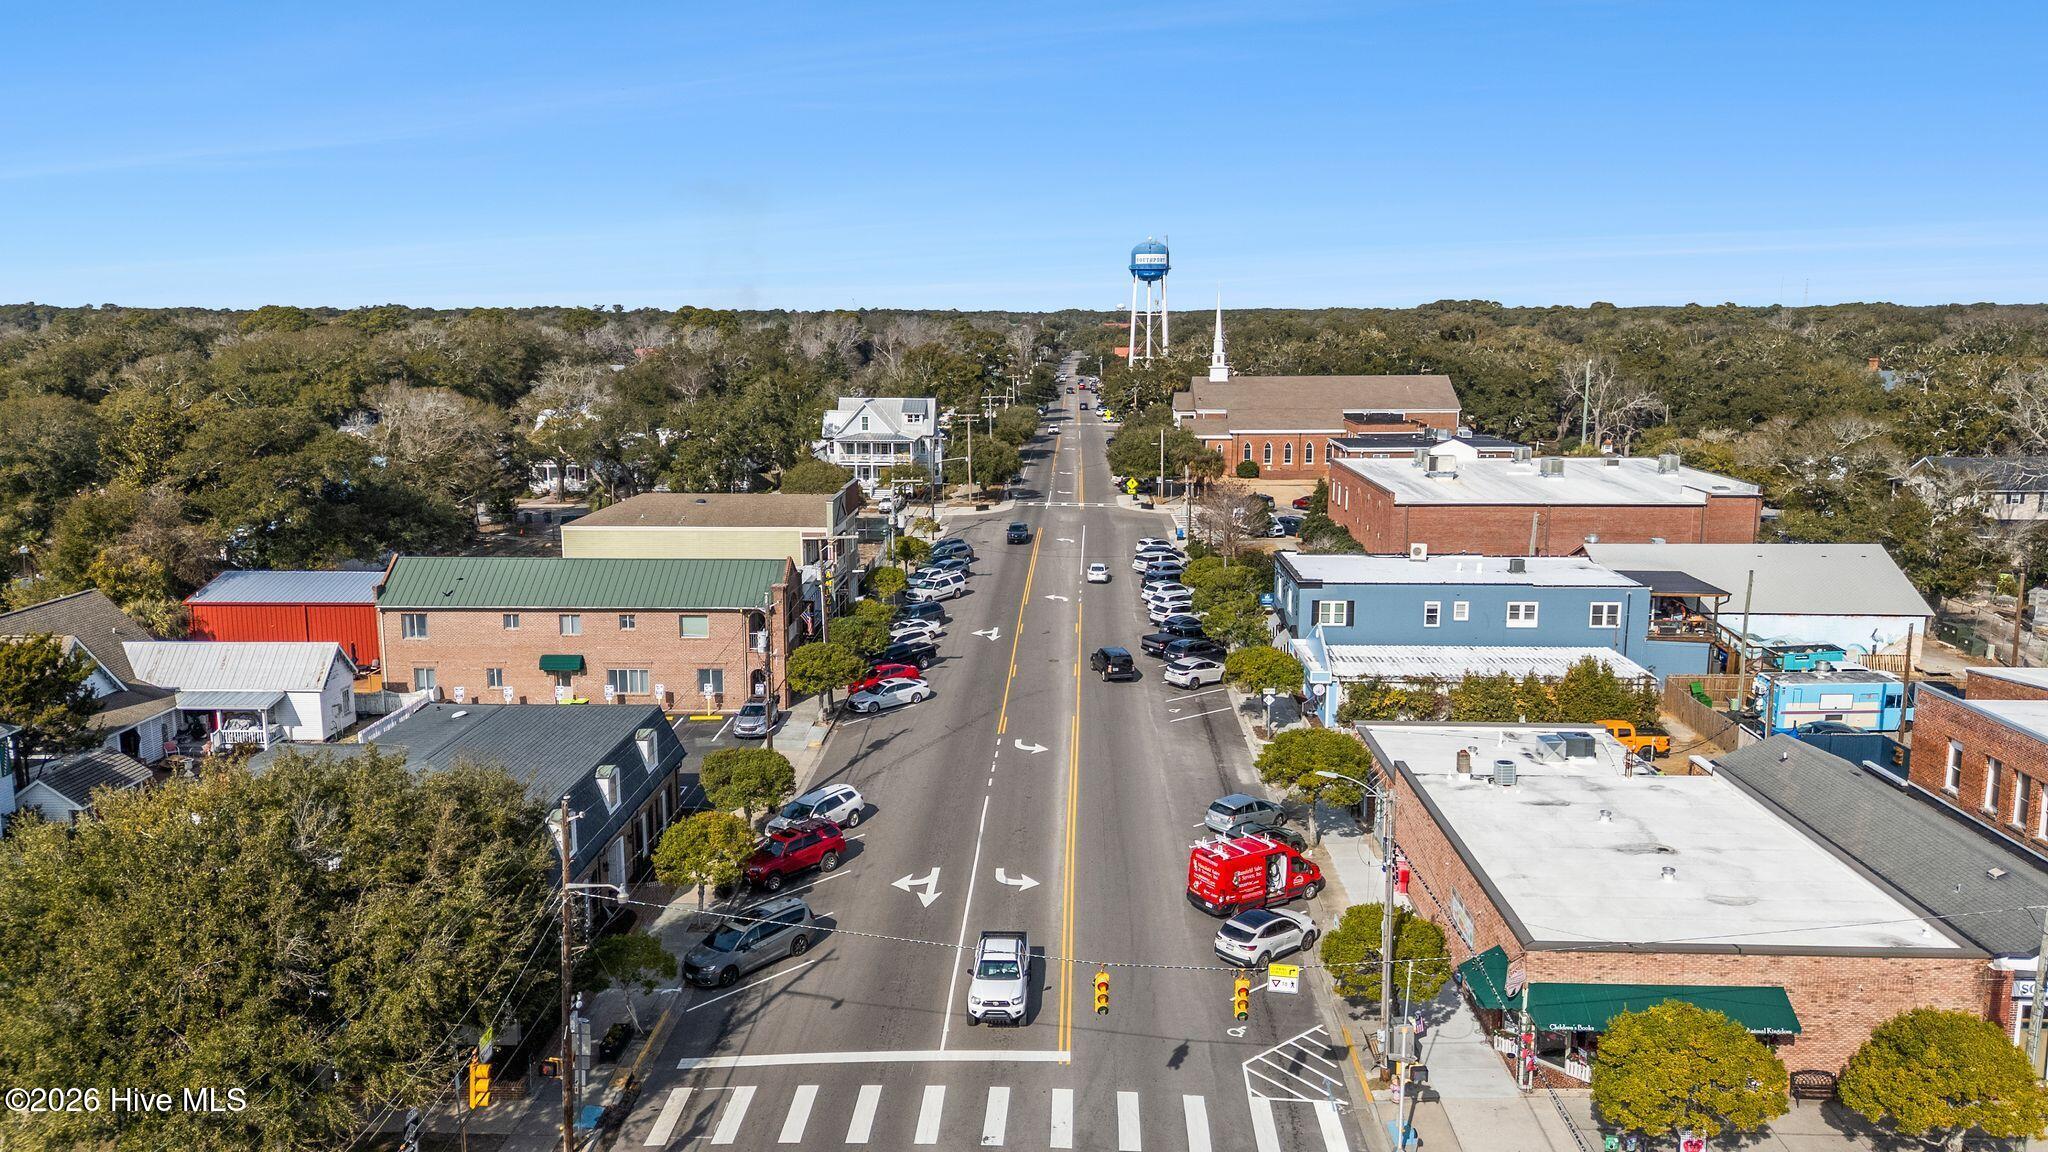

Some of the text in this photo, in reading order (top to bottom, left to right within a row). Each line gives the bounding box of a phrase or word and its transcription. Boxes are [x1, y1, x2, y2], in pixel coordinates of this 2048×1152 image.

[825, 570, 833, 613] AMUZU
[1549, 1023, 1578, 1031] Children's
[1767, 1027, 1793, 1035] Kingdom
